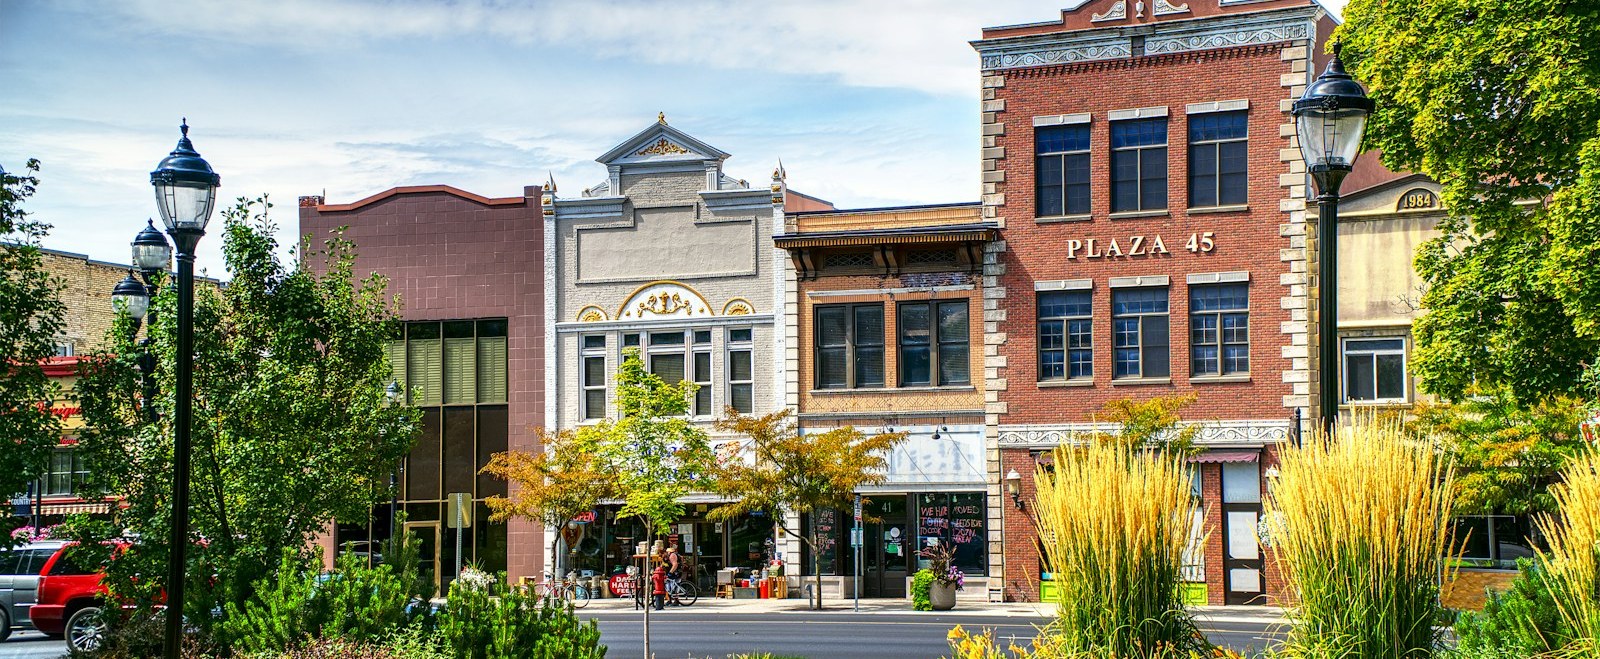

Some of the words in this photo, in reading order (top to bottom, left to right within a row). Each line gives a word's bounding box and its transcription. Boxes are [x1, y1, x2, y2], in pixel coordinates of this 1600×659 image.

[1403, 193, 1432, 208] 1984
[1066, 233, 1170, 260] PLAZA
[1185, 231, 1215, 253] 45
[881, 501, 892, 513] 41
